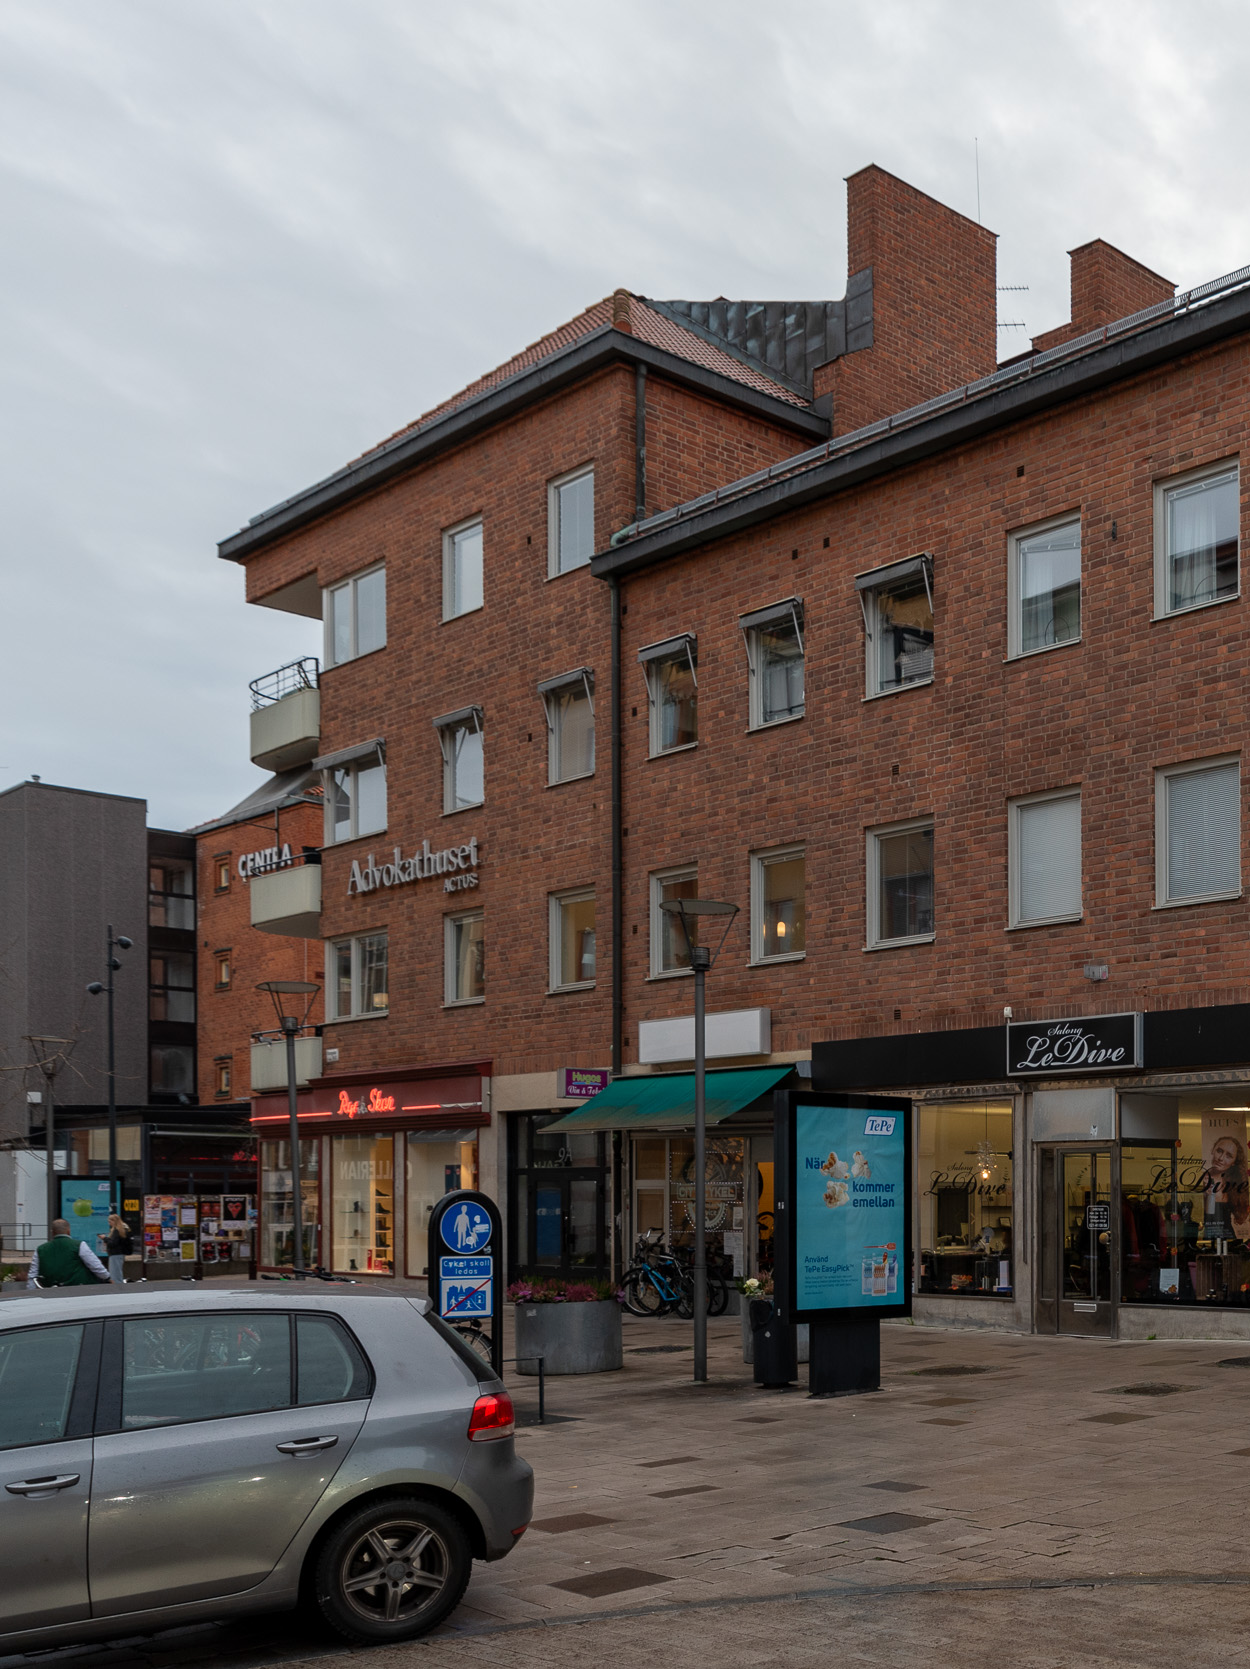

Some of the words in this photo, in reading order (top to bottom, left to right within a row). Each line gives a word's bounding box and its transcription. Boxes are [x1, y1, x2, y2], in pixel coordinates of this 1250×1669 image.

[347, 836, 480, 895] Advokathuset
[443, 873, 479, 893] ACTUS
[1047, 1023, 1083, 1042] Salong
[572, 1072, 601, 1084] Hugos
[869, 1119, 892, 1132] TePe
[558, 1147, 572, 1161] 9A
[805, 1157, 825, 1169] När
[852, 1181, 895, 1193] kommer
[852, 1196, 895, 1208] emellan
[443, 1260, 467, 1268] Cykel
[469, 1259, 490, 1267] skall
[805, 1265, 821, 1273] TePe
[455, 1267, 478, 1275] ledas
